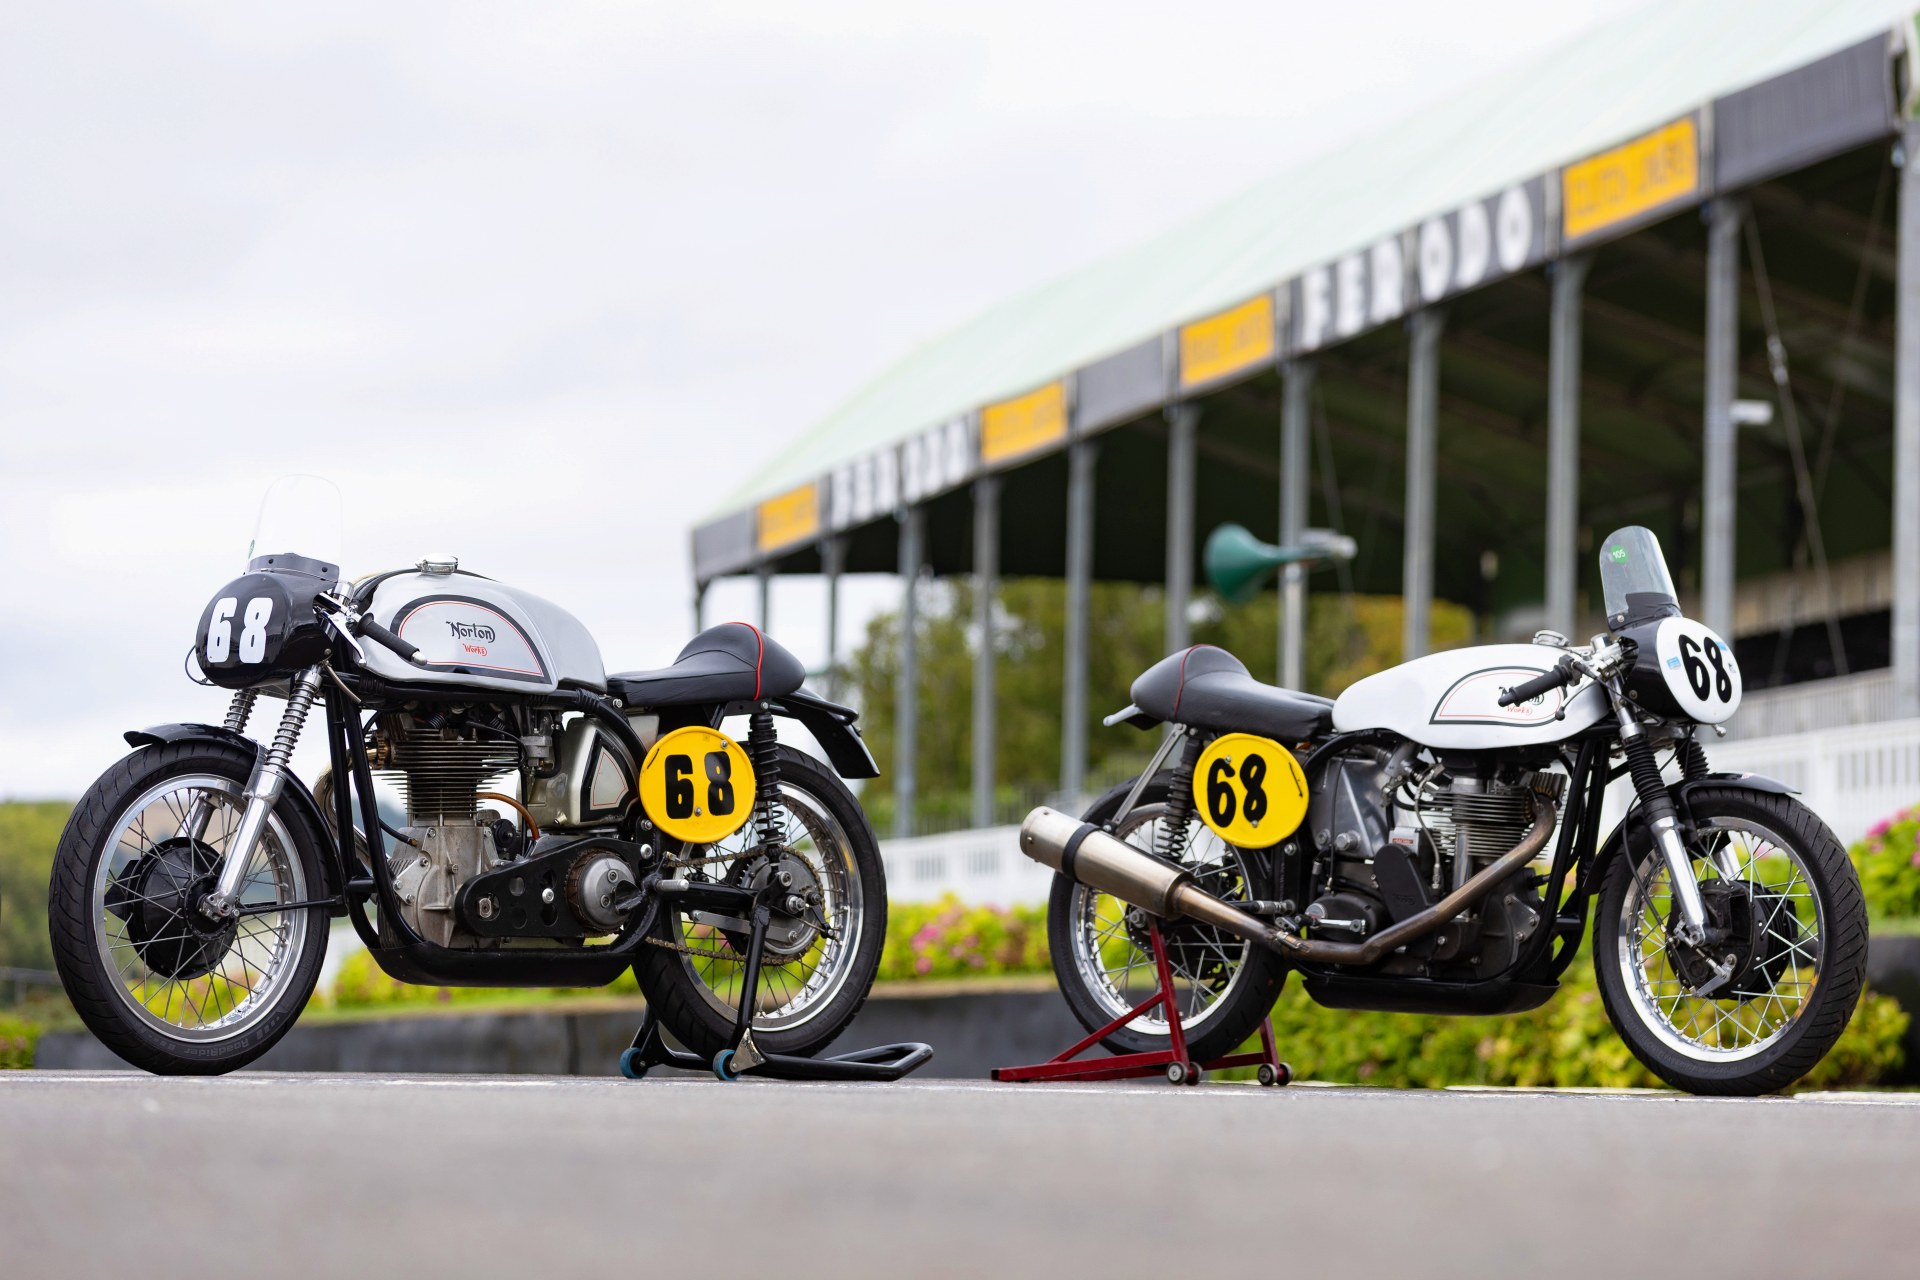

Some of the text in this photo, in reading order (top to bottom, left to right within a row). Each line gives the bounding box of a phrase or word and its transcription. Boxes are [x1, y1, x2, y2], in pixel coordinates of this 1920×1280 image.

[206, 597, 274, 664] 68
[446, 621, 496, 643] Norton
[463, 643, 488, 656] Works
[1678, 634, 1732, 703] 68
[664, 750, 735, 819] 68
[1207, 753, 1267, 828] 68
[184, 1040, 250, 1057] RoadRider
